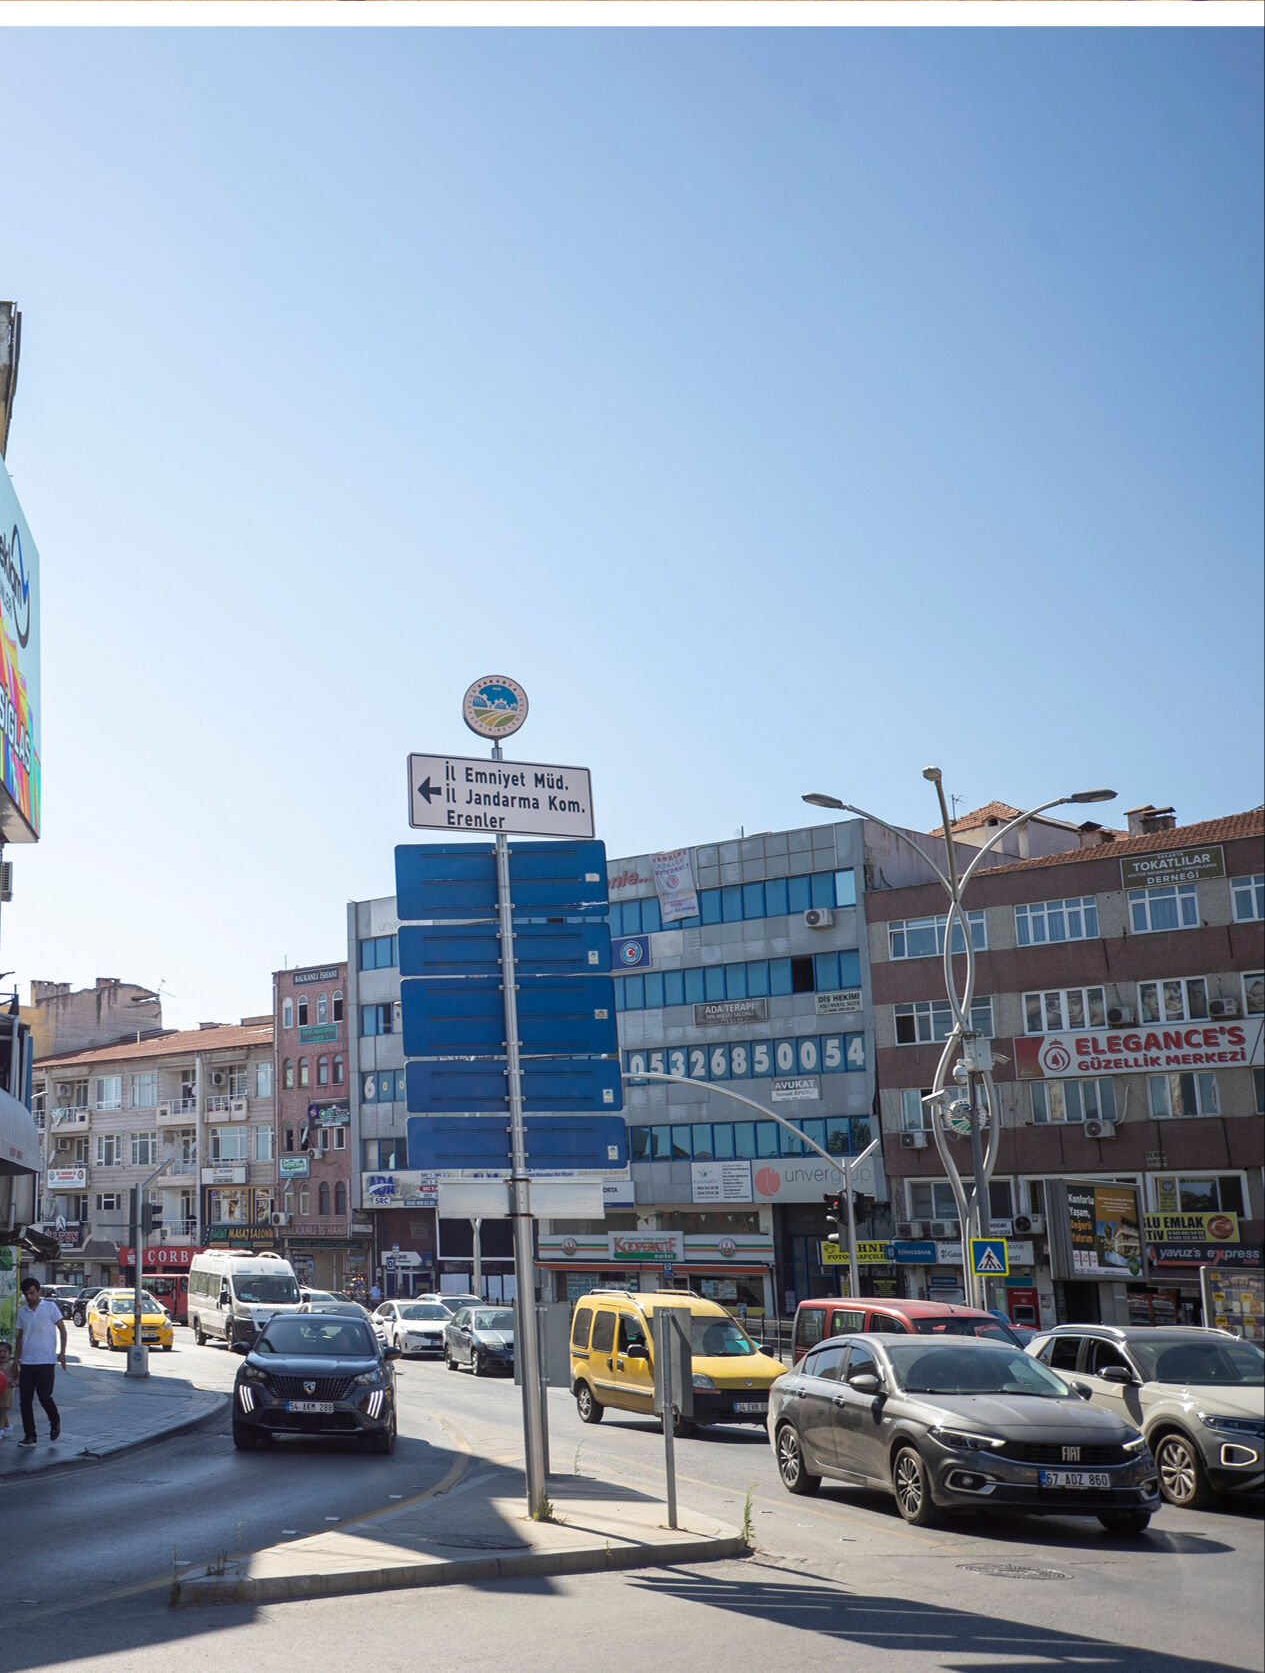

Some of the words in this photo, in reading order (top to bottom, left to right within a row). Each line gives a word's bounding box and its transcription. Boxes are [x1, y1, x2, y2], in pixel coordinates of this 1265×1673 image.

[445, 761, 456, 781] İl
[465, 767, 526, 789] Emniyet
[534, 773, 569, 790] Müd.
[465, 789, 540, 810] Jandarma
[548, 796, 586, 813] Kom.
[447, 810, 506, 828] Erenler
[1132, 853, 1211, 872] TOKATLILAR
[1147, 870, 1199, 885] DERNEĞİ
[818, 994, 832, 1003] DİŞ
[833, 992, 861, 1001] HEKİMİ
[704, 1006, 722, 1015] ADA
[724, 1003, 754, 1014] TERAPİ
[1075, 1026, 1247, 1056] ELEGANCE'S
[1077, 1053, 1162, 1071] GÜZELLİK
[1165, 1047, 1247, 1066] MERKEZİ
[775, 1079, 816, 1090] AVUKAT
[369, 1176, 395, 1195] ADA
[375, 1197, 389, 1205] SRC
[1068, 1194, 1094, 1205] Konforlu
[1069, 1207, 1091, 1218] Yaşam,
[1163, 1216, 1204, 1229] EMLAK
[1145, 1230, 1165, 1241] TİV
[858, 1241, 886, 1252] HNE
[1159, 1248, 1201, 1259] yavuz's
[1207, 1249, 1260, 1260] express
[288, 1401, 300, 1412] 54
[303, 1402, 316, 1412] AKM
[320, 1402, 334, 1412] 288
[1061, 1446, 1083, 1462] FIAT
[1047, 1472, 1058, 1485] 67
[1065, 1473, 1083, 1485] ADZ
[1089, 1474, 1108, 1486] 860
